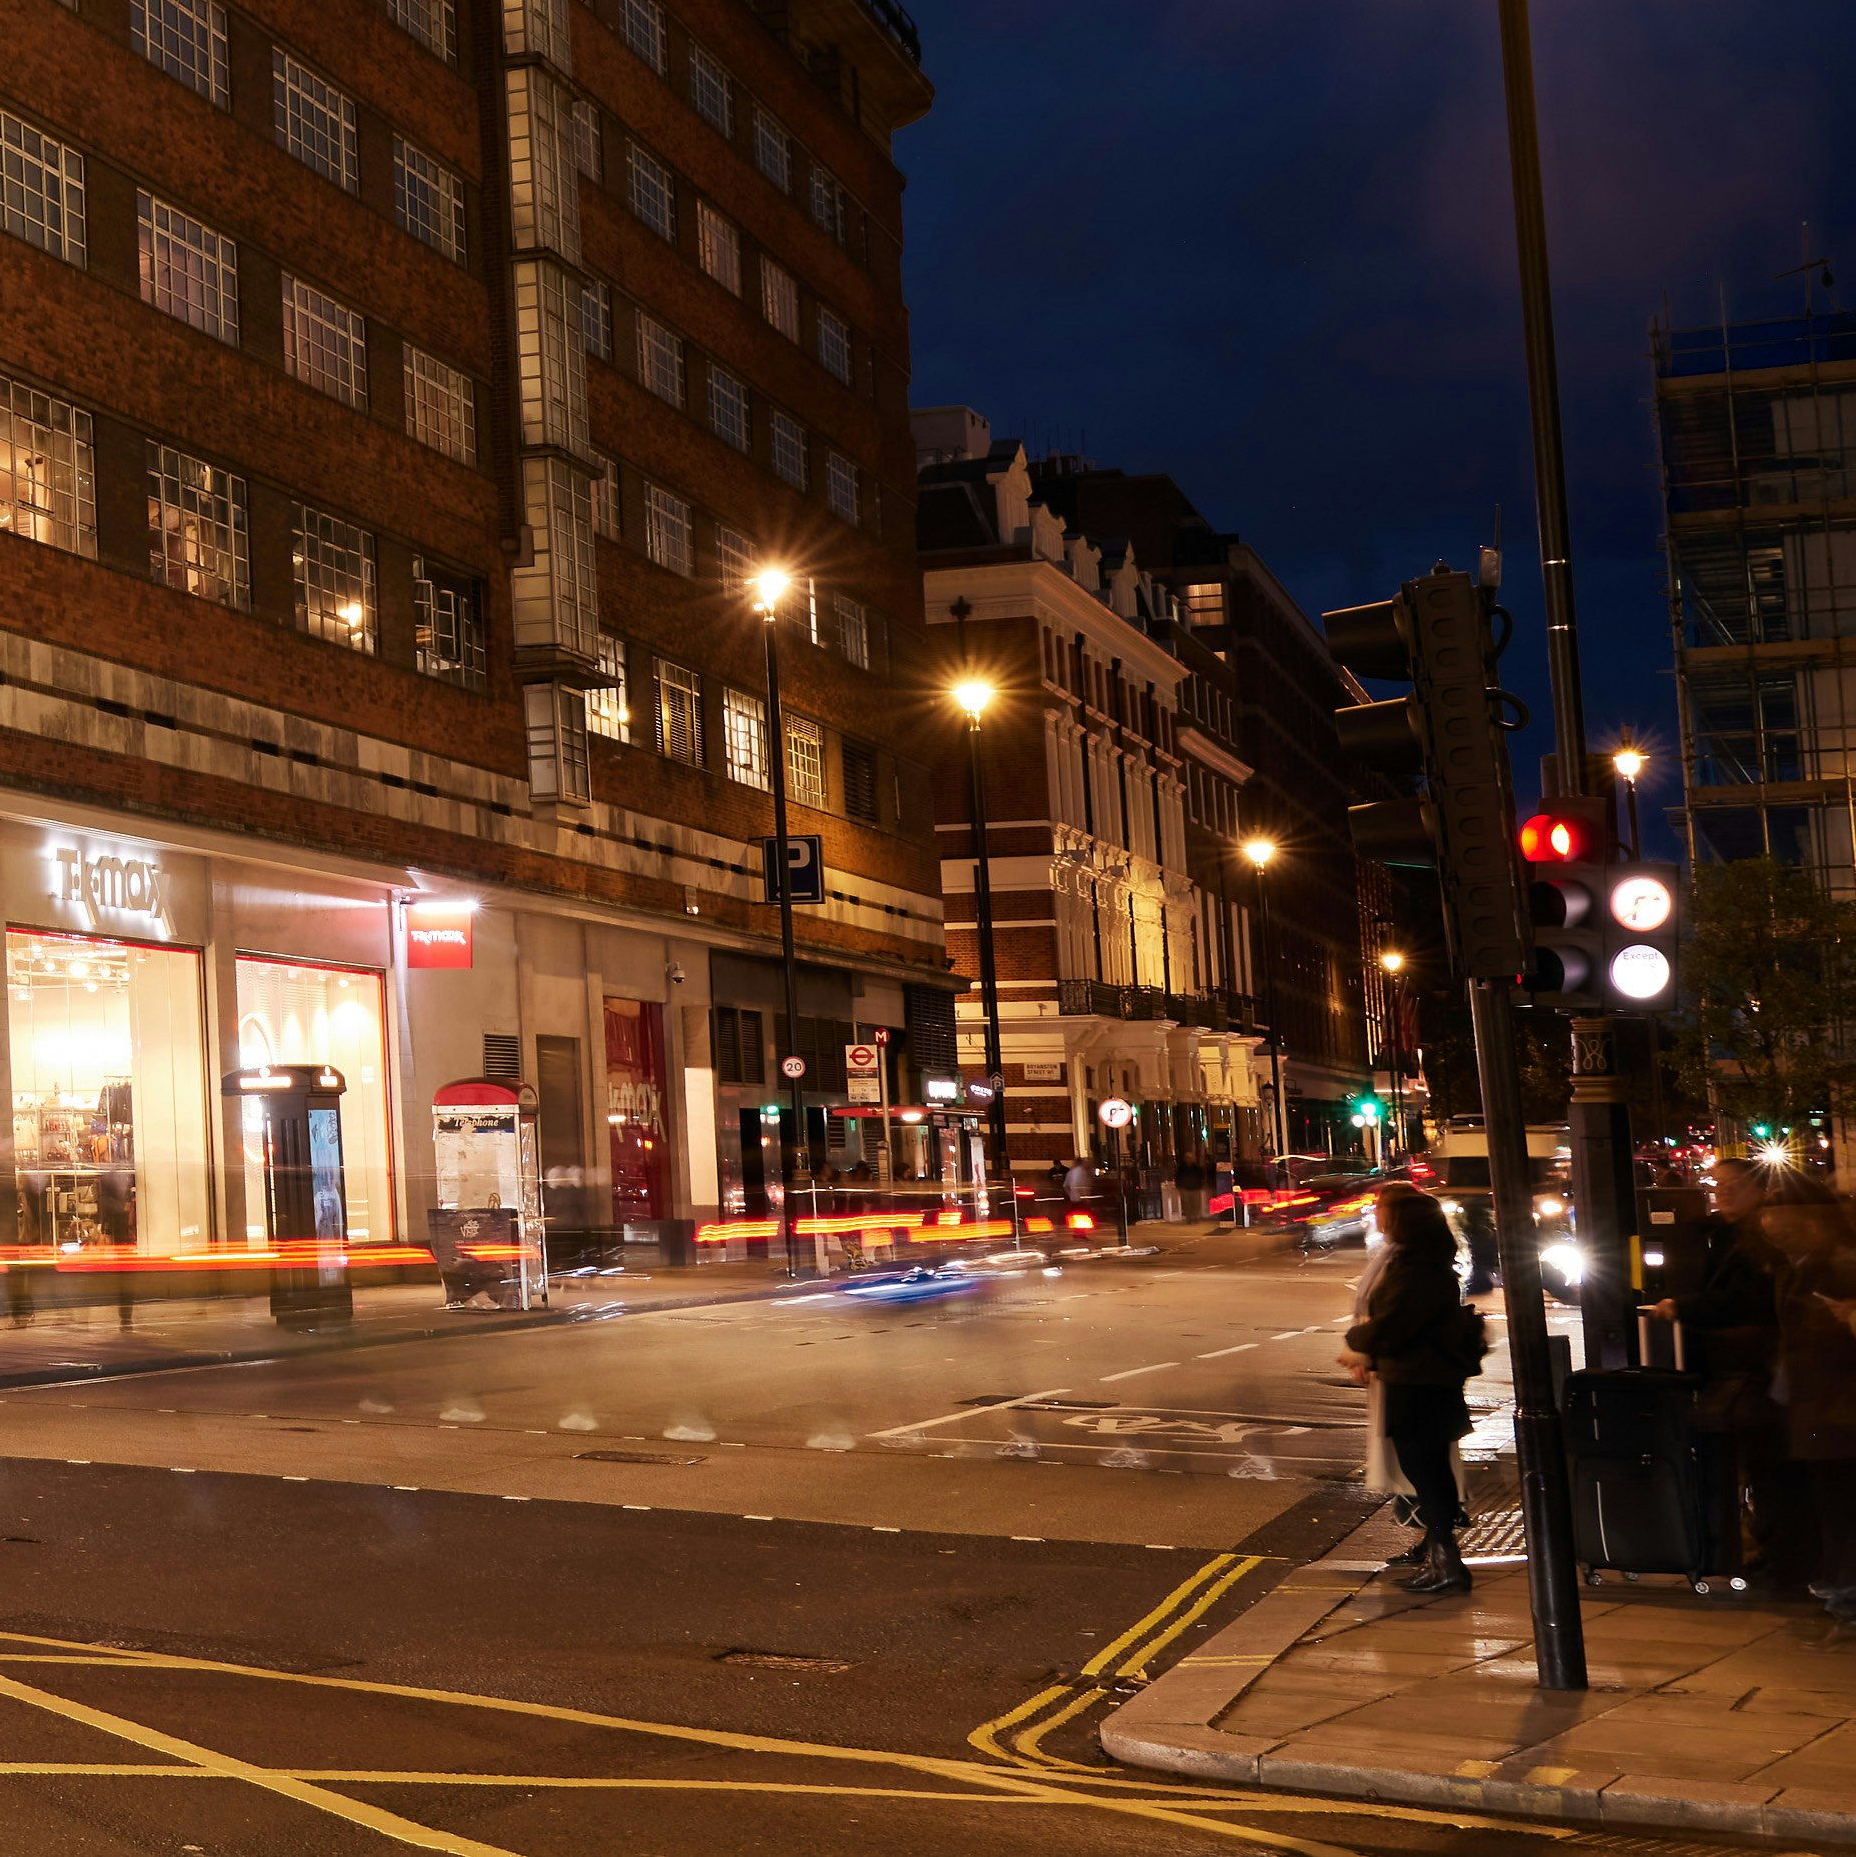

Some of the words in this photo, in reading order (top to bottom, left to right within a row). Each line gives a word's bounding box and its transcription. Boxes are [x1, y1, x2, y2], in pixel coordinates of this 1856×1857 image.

[1623, 951, 1659, 960] Except
[875, 1031, 888, 1042] M
[785, 1062, 802, 1072] 20
[454, 1117, 499, 1127] Tephone
